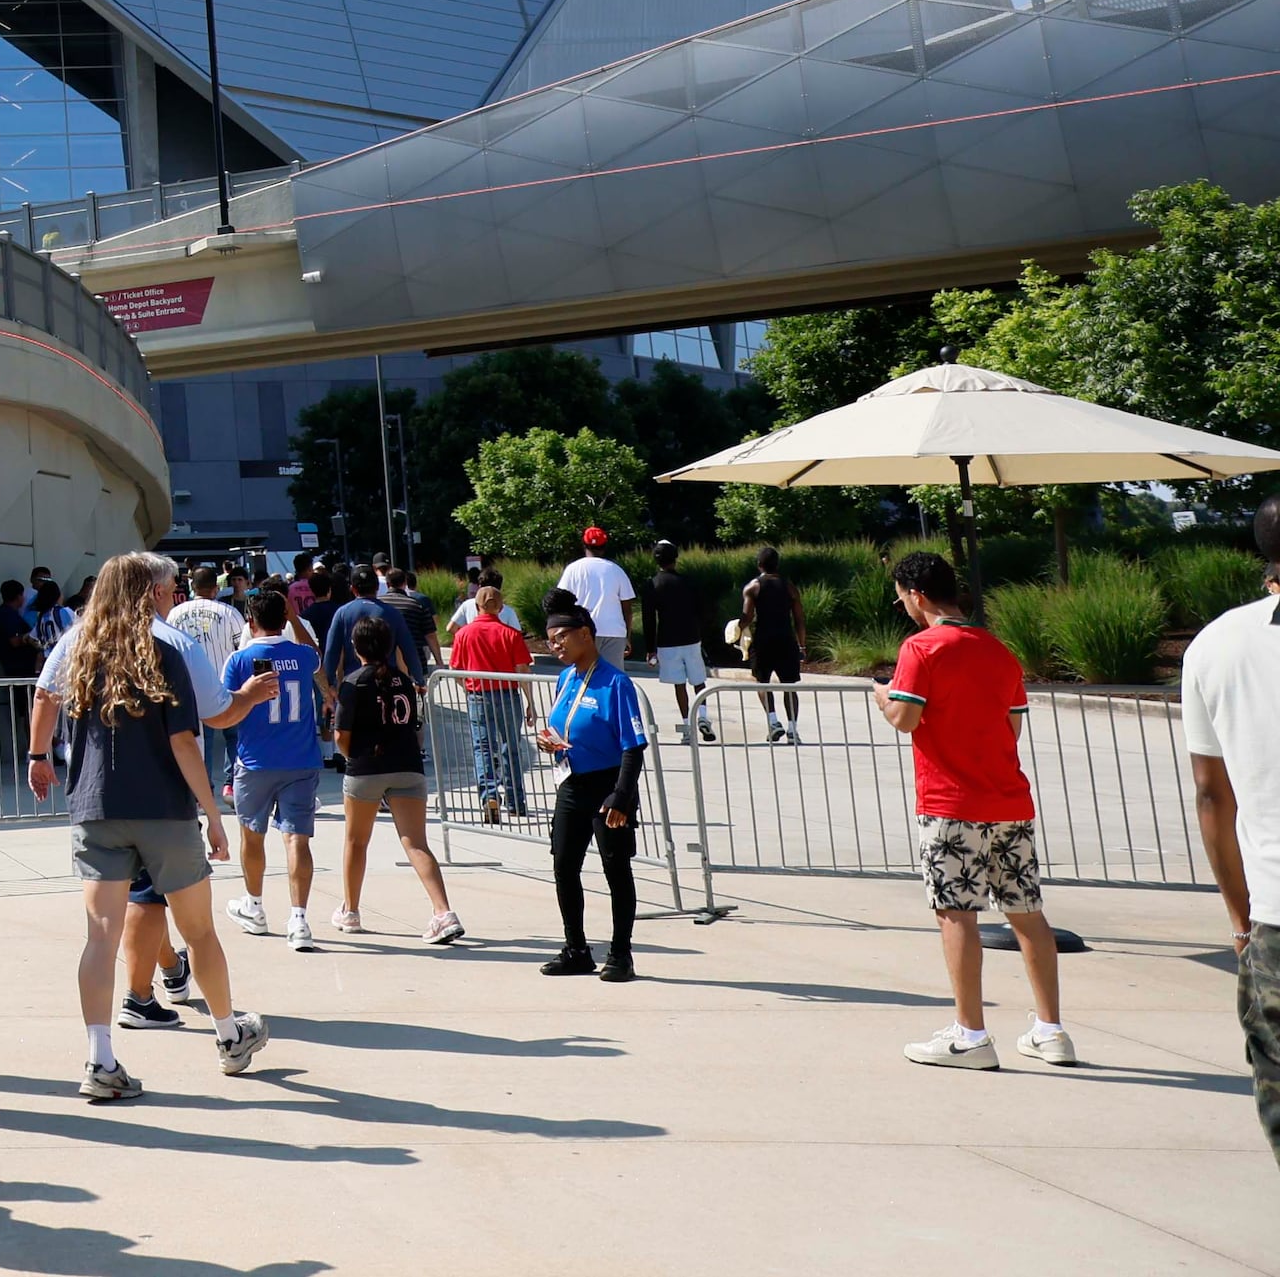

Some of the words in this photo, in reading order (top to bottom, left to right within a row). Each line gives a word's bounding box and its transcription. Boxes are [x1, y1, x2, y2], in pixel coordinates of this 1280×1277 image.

[122, 291, 144, 300] Ticket
[144, 288, 165, 297] Office
[108, 304, 128, 312] Home
[129, 300, 149, 310] Depot
[150, 296, 182, 307] Backyard
[138, 309, 155, 318] Suite
[156, 306, 186, 317] Entrance
[272, 659, 299, 671] GICO
